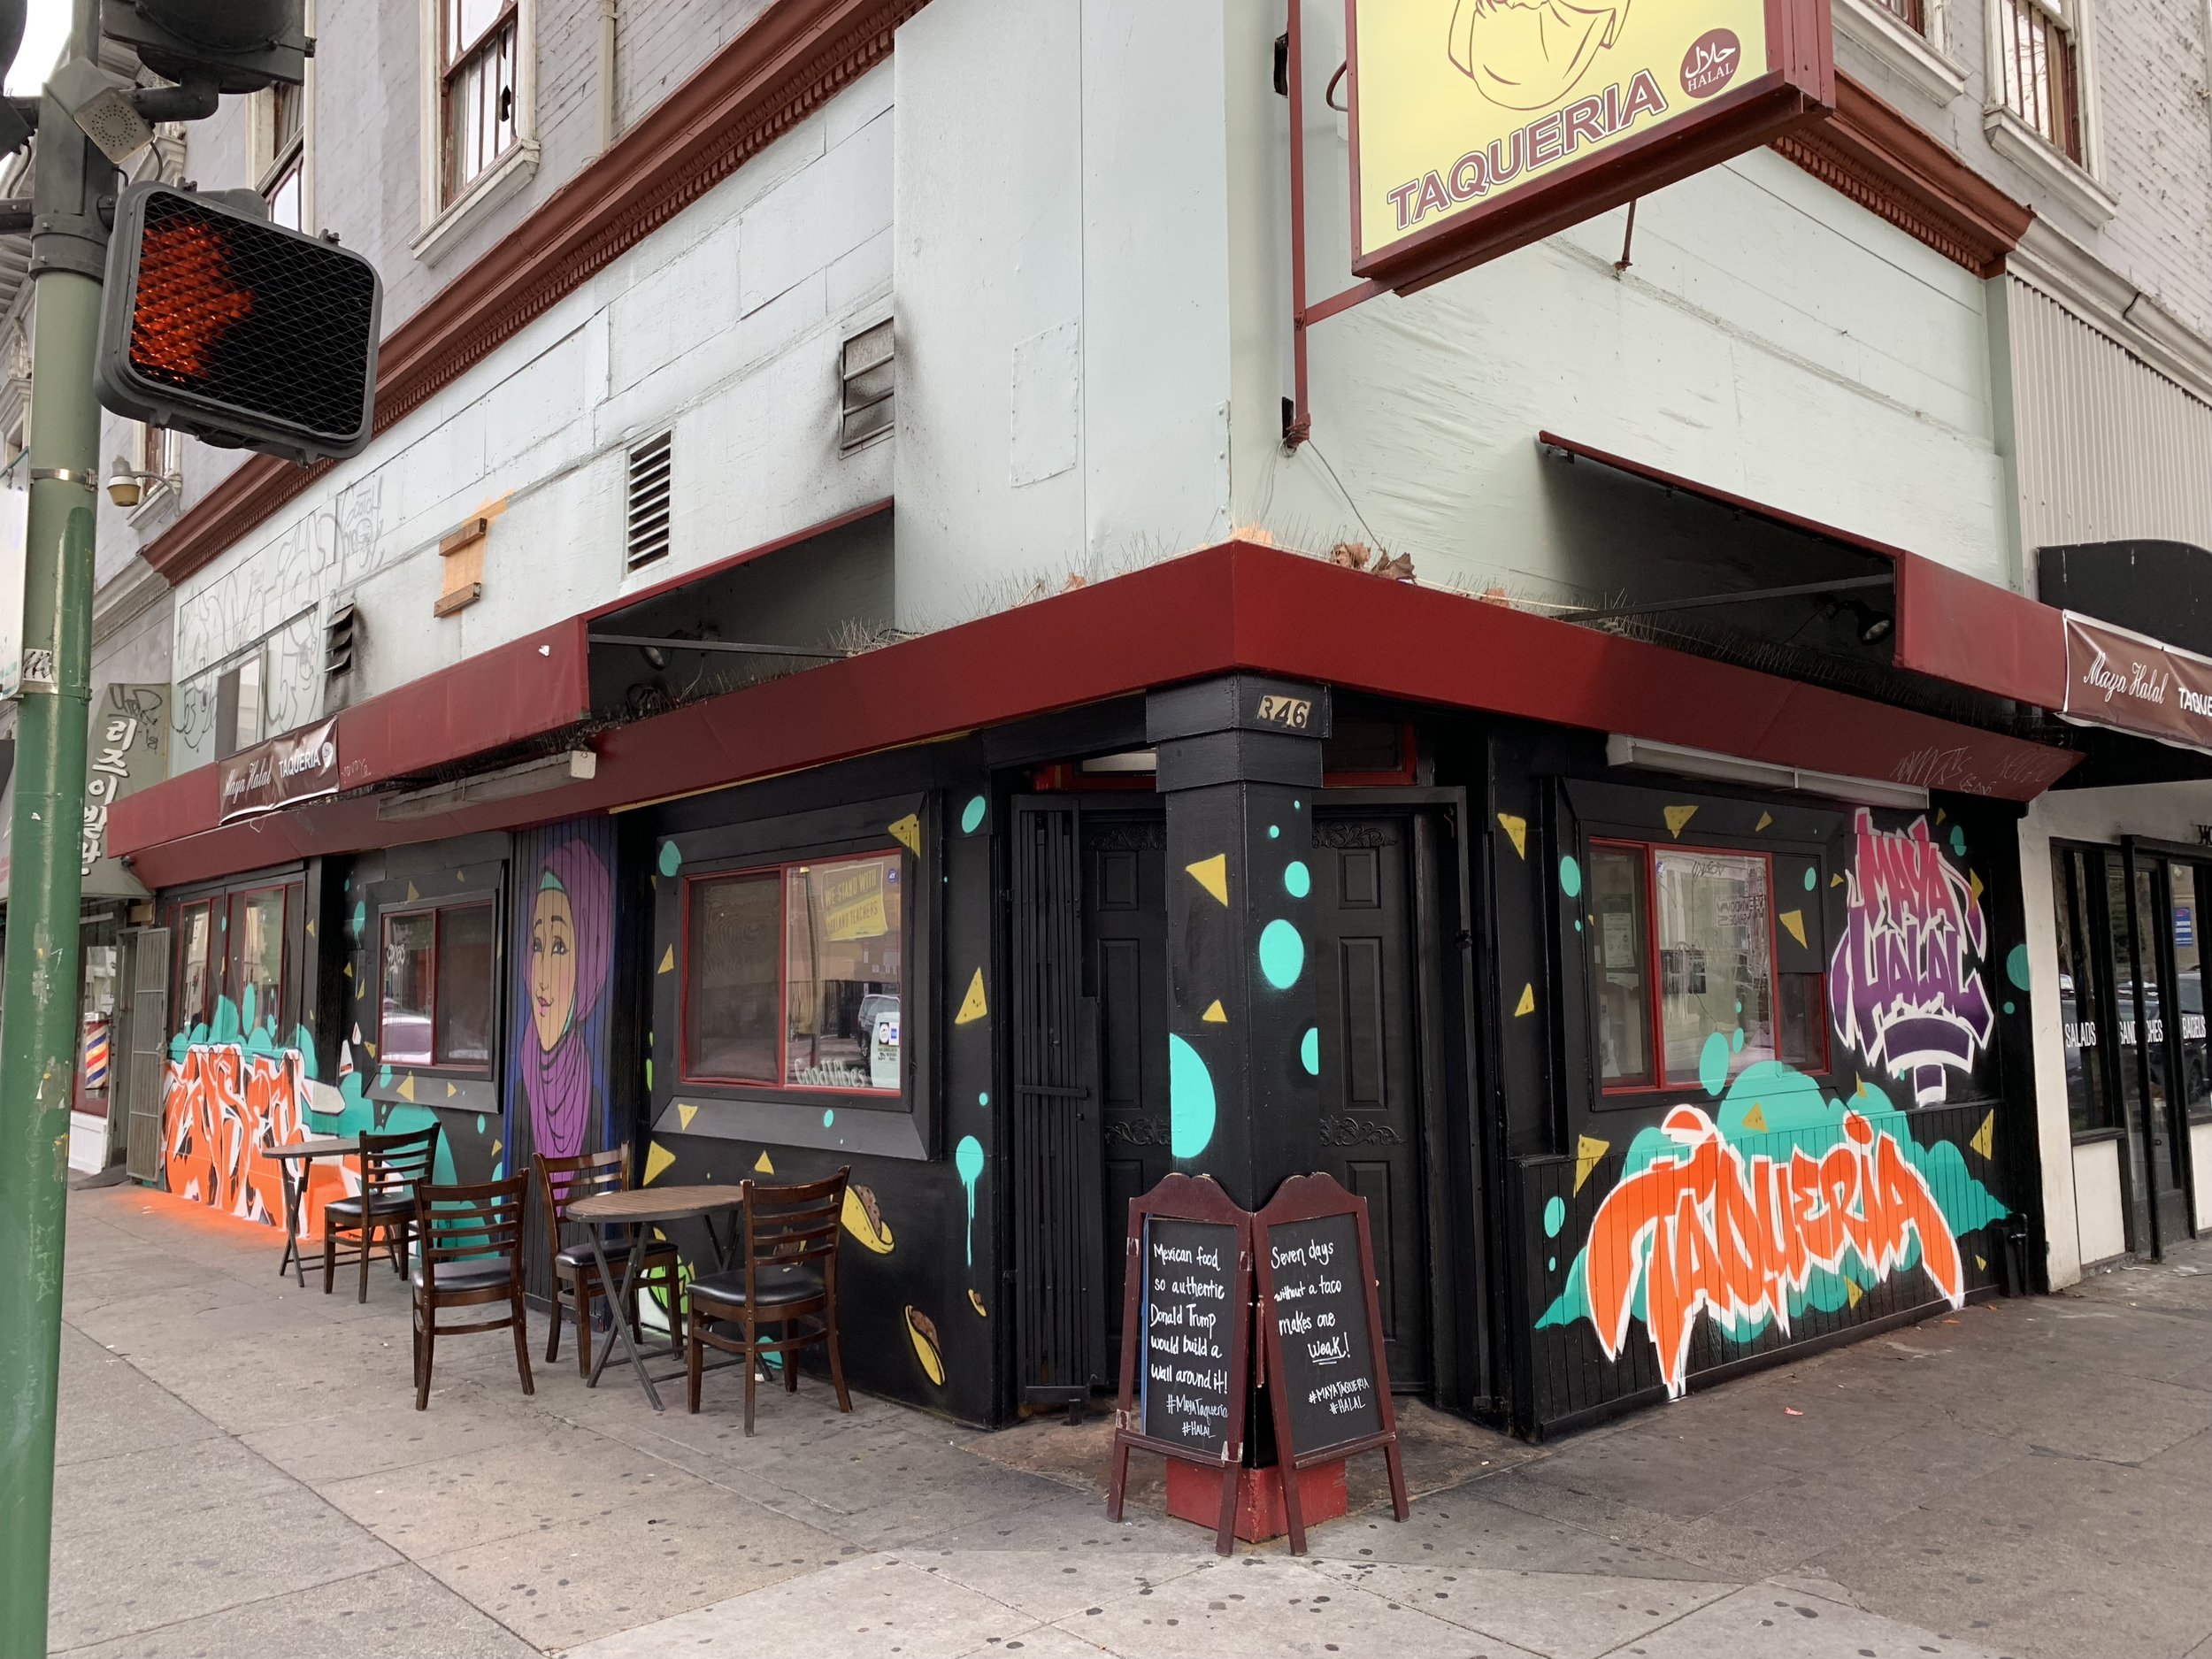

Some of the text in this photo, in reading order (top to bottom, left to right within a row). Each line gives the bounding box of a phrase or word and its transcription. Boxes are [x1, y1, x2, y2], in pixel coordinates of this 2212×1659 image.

[1685, 42, 1736, 79] حلال
[1687, 63, 1733, 92] HALAL
[1386, 68, 1670, 231] TAQUERIA
[2084, 650, 2127, 703] Maya
[2129, 662, 2169, 704] Halal
[1259, 696, 1308, 728] 346
[247, 756, 274, 791] Halal
[278, 748, 321, 779] TAQUERIA
[825, 868, 877, 907] WE STAND WITH
[1847, 807, 1982, 945] MAYA
[849, 900, 878, 925] TEACHERS
[2064, 1021, 2096, 1048] SALADS
[2182, 1015, 2207, 1040] BAGELS
[1153, 1243, 1221, 1271] Mexican food
[1271, 1239, 1333, 1269] Seven days
[1154, 1276, 1225, 1300] so authentic
[1274, 1274, 1341, 1302] without a taco
[1150, 1303, 1217, 1340] Donald Trump
[1279, 1310, 1336, 1336] makes one
[1150, 1334, 1223, 1359] would build a
[1176, 1369, 1212, 1390] around
[1213, 1369, 1228, 1395] it!
[1309, 1378, 1370, 1404] #MAYATAQUERIA
[1330, 1395, 1366, 1415] #HALAL
